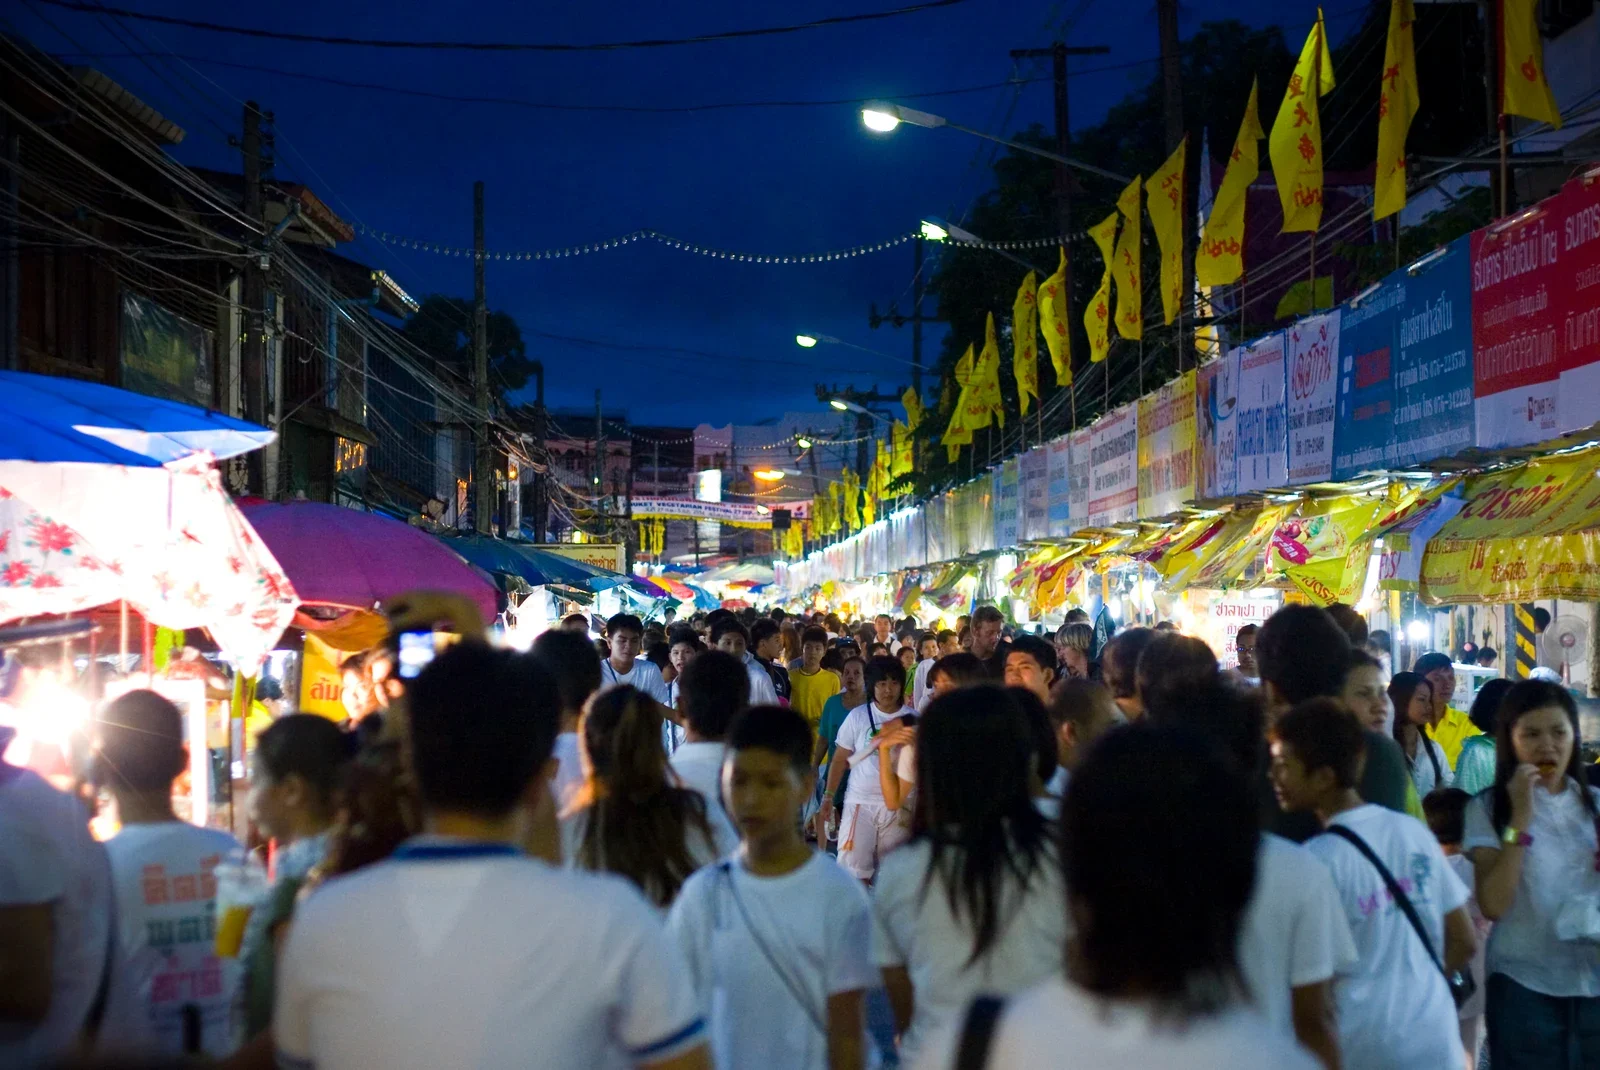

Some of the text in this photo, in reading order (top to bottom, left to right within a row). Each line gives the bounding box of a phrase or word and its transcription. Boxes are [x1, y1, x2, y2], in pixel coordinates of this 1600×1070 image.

[656, 501, 702, 509] VEGETARIAN
[704, 505, 732, 513] FESTIVAL
[1215, 602, 1255, 617] ซาลาเปา
